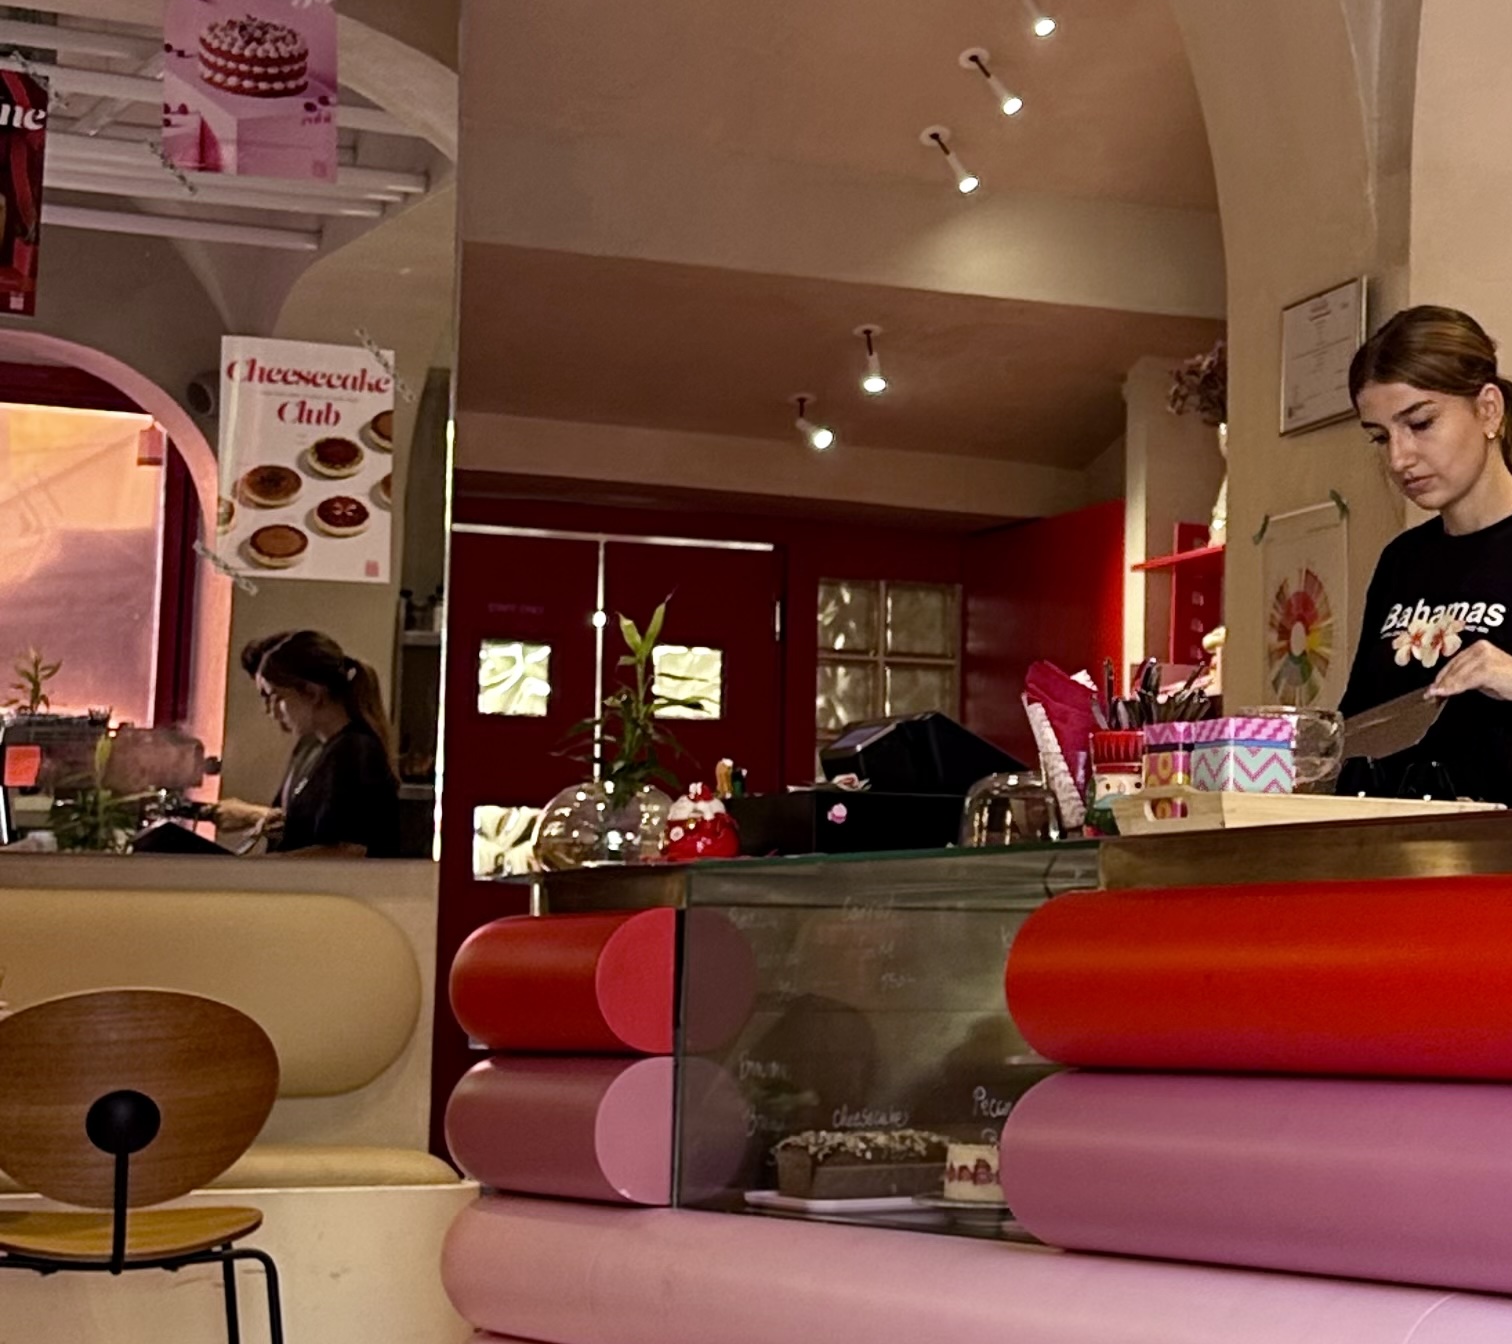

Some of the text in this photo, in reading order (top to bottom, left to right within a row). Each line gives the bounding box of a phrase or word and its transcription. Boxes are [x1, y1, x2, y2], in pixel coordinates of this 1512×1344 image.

[227, 357, 391, 394] Cheesecake
[277, 400, 341, 426] Club
[1380, 598, 1506, 634] Bahamas
